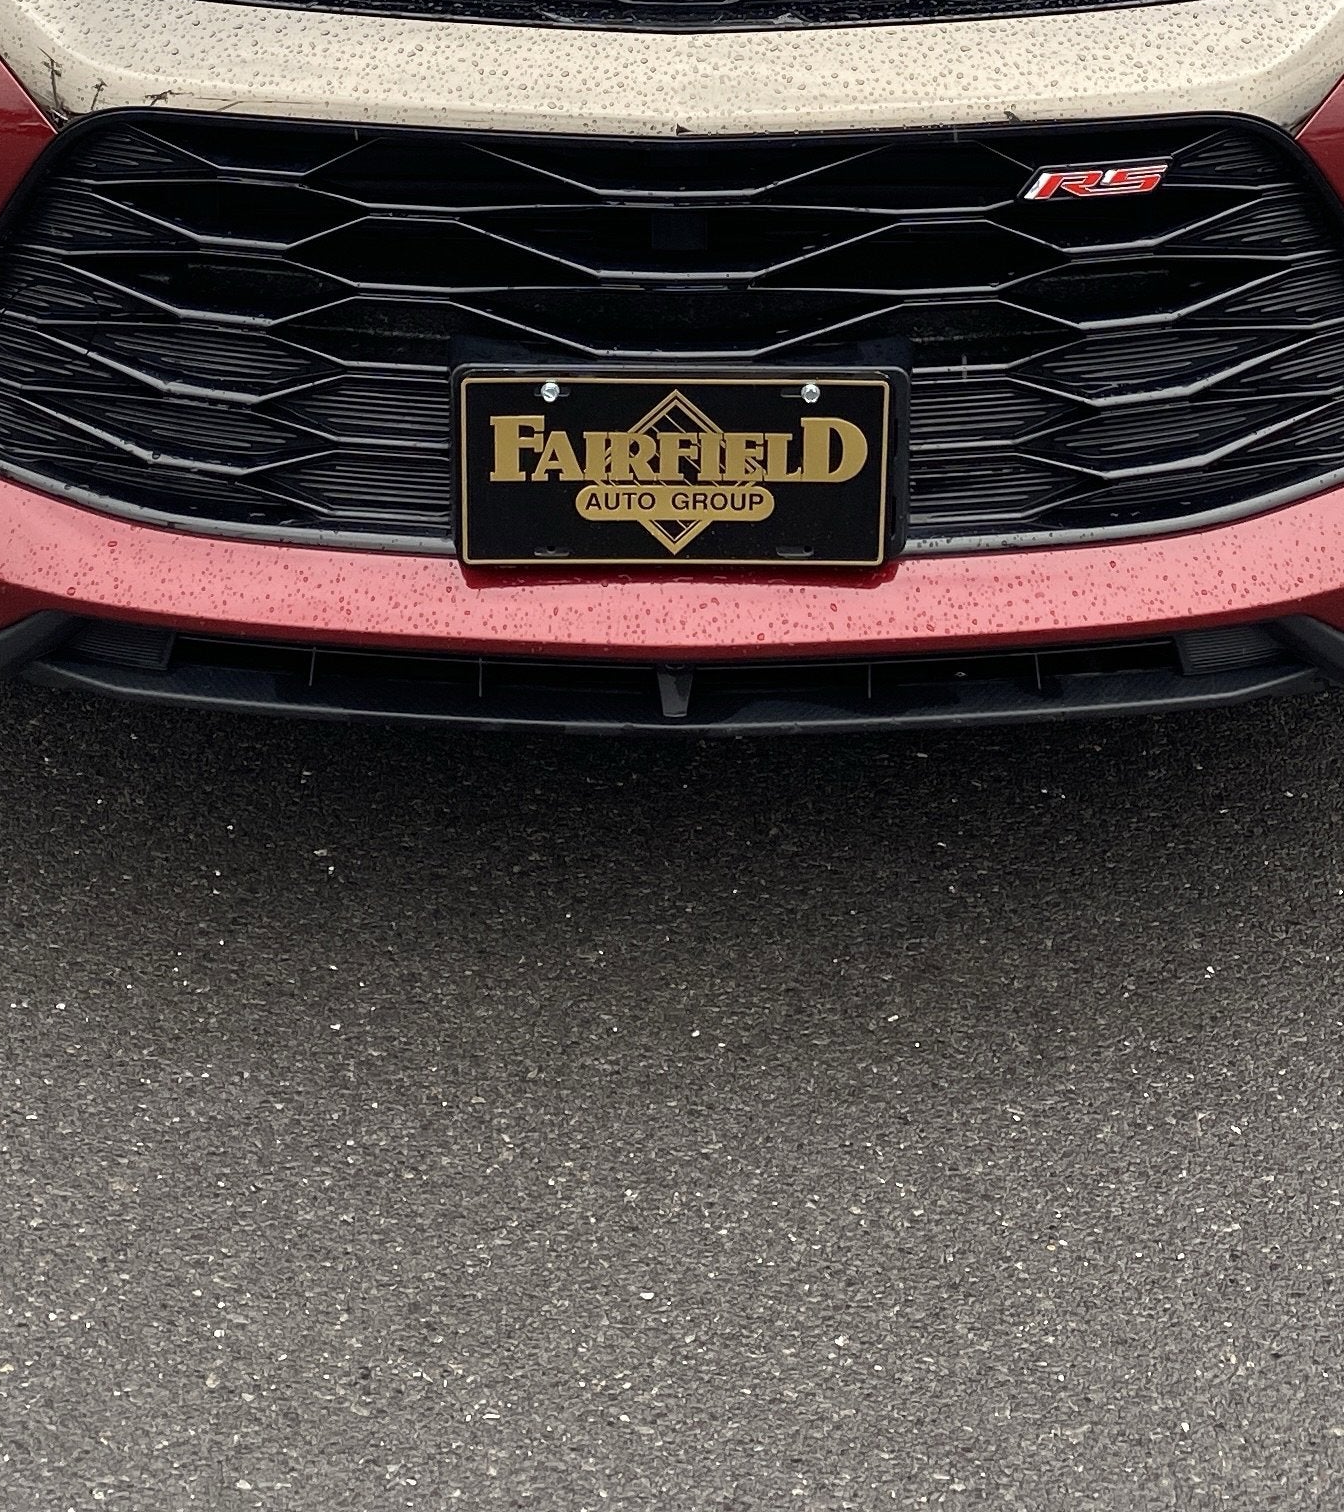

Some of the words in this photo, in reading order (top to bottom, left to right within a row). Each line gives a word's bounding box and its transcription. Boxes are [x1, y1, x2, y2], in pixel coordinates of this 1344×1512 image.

[1023, 164, 1169, 200] RS
[489, 415, 869, 483] FAIRFIELD
[584, 492, 657, 511] AUTO
[671, 492, 765, 511] GROUP
